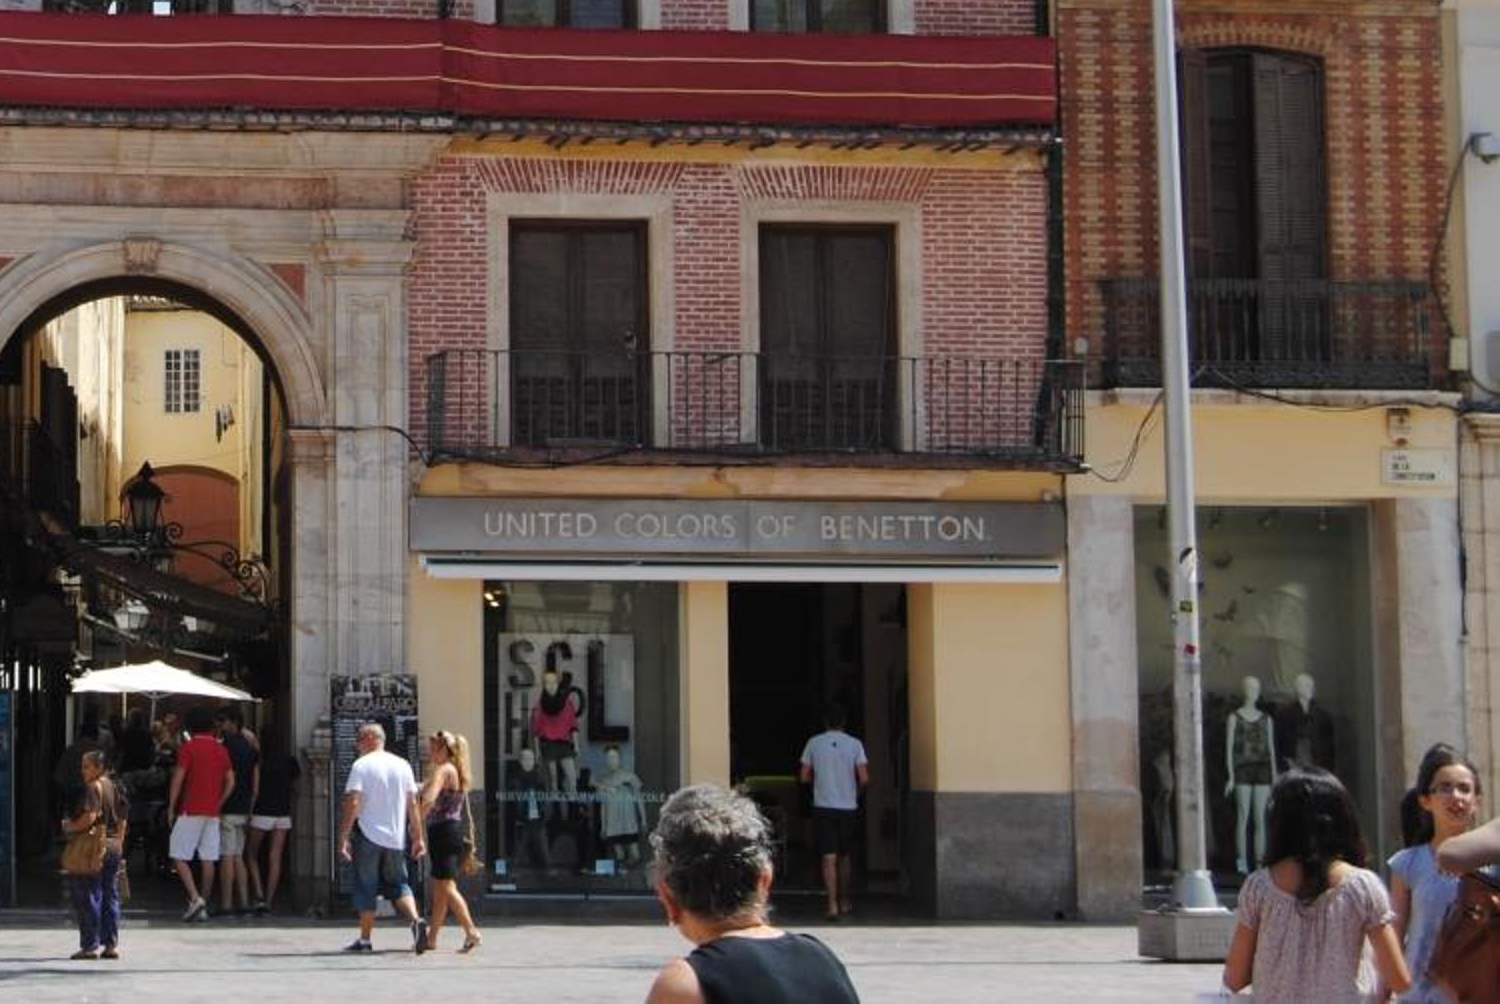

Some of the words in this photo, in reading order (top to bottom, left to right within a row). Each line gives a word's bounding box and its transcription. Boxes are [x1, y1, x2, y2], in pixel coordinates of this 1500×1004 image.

[484, 511, 597, 538] UNITED
[614, 512, 737, 538] COLORS
[756, 515, 796, 539] OF
[820, 515, 984, 541] BENETTON
